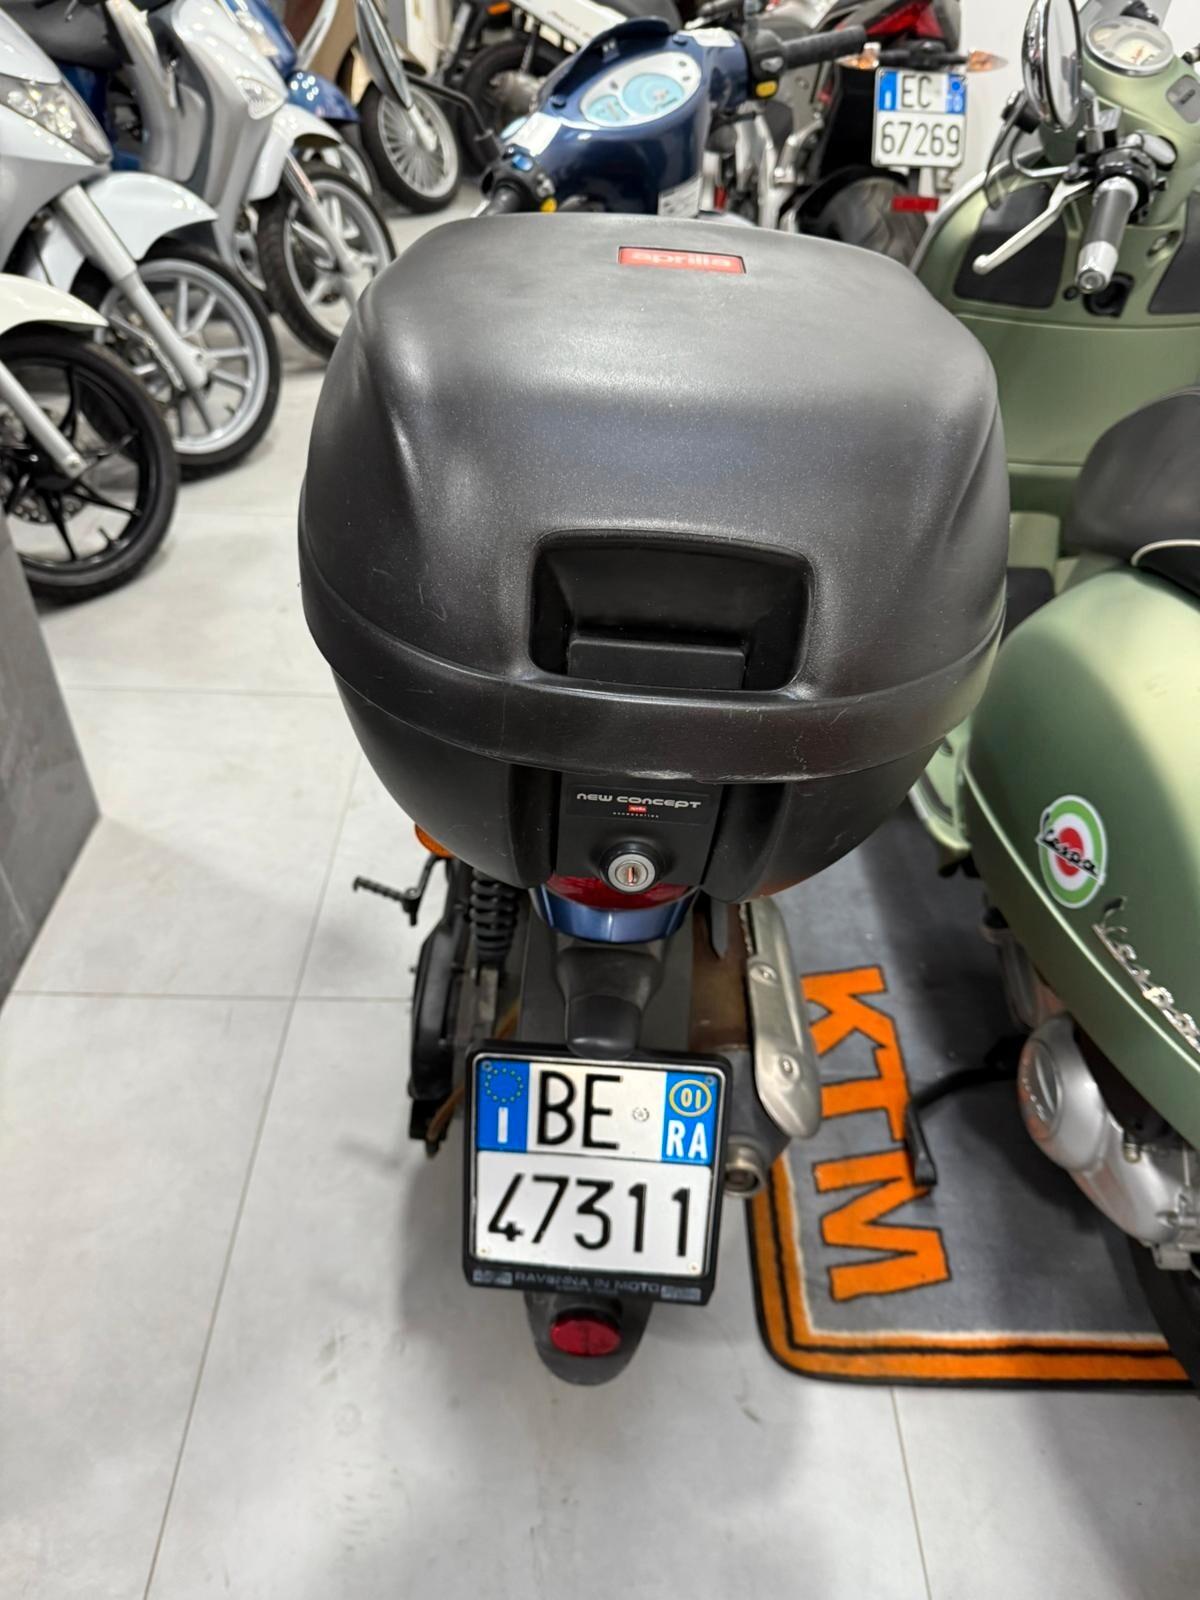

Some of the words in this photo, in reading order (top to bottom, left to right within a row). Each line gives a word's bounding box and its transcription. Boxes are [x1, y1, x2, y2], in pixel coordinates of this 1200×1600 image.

[902, 75, 932, 109] EC
[881, 120, 961, 158] 67269
[631, 252, 732, 267] aprilia
[1038, 811, 1101, 880] Vespa
[497, 1106, 509, 1144] I
[536, 1070, 624, 1151] BE
[800, 964, 952, 1302] KTM
[665, 1119, 708, 1160] RA
[487, 1172, 692, 1258] 47311
